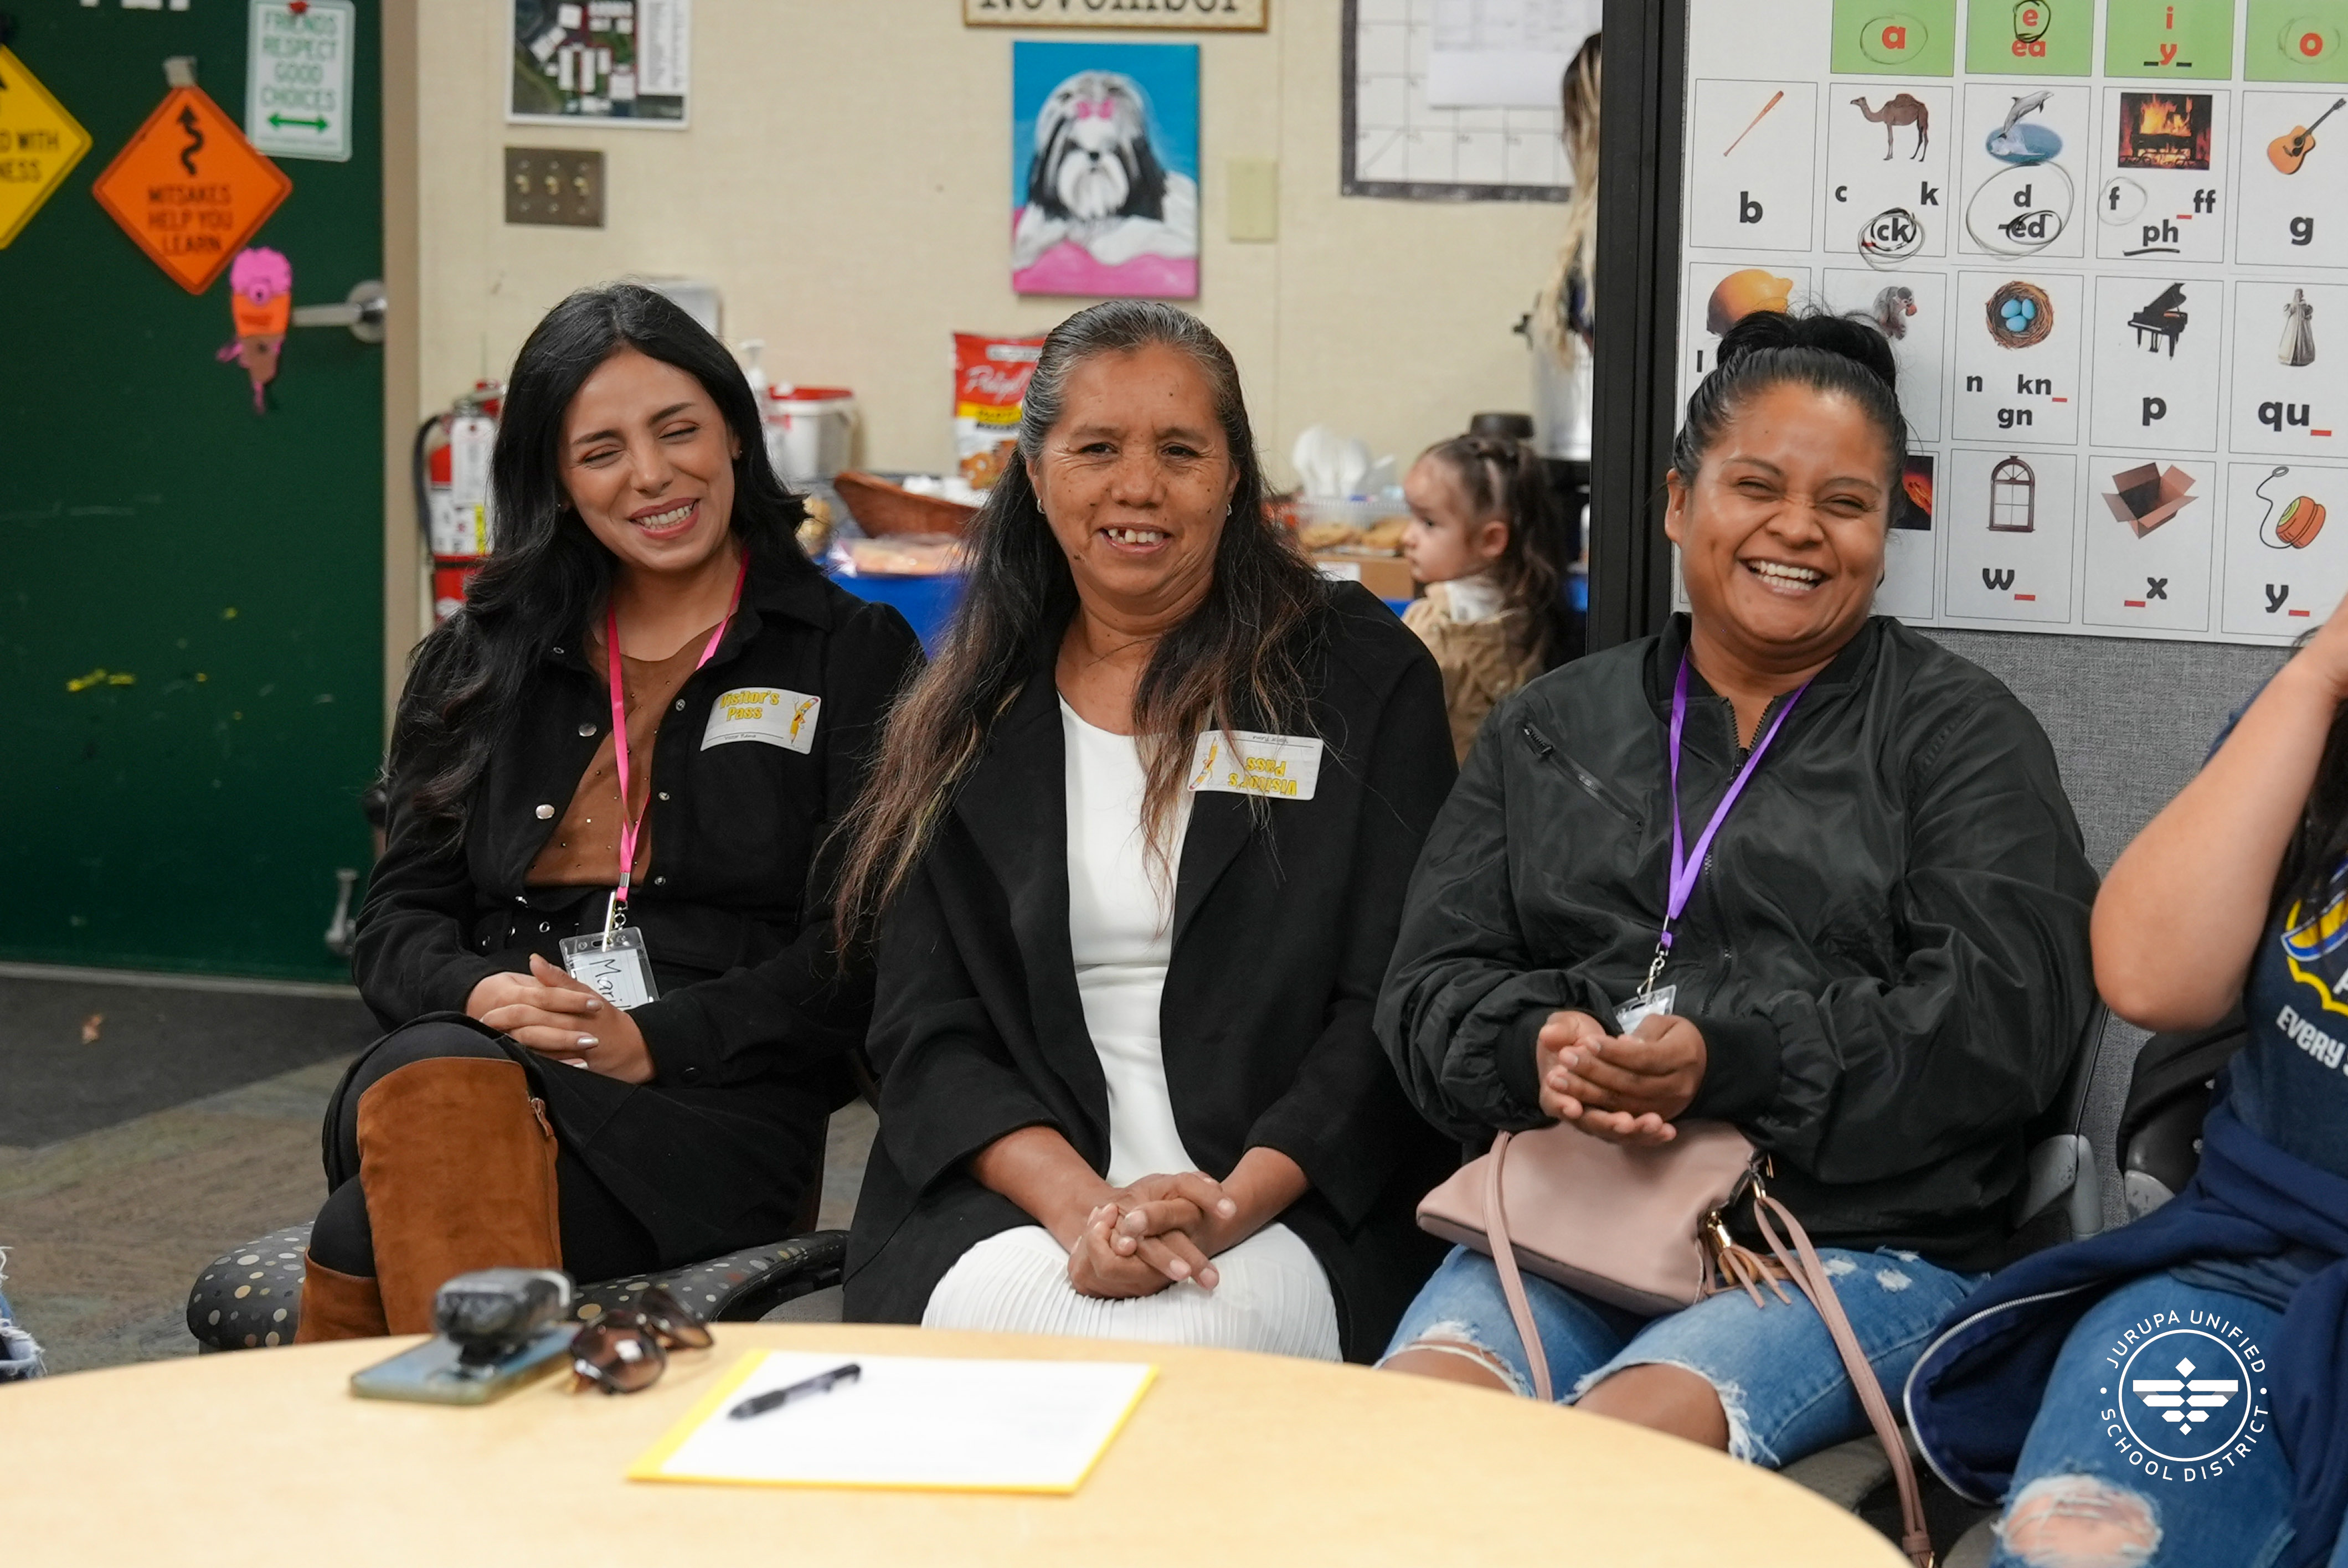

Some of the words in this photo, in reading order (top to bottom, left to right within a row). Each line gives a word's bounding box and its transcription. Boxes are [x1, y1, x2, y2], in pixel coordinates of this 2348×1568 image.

[2022, 9, 2038, 27] e
[2166, 7, 2173, 29] i
[1882, 27, 1906, 49] a
[2012, 39, 2046, 57] ea
[2300, 33, 2323, 56] o
[1835, 185, 1847, 203] c
[1920, 181, 1939, 205] k
[2014, 184, 2032, 208] d
[2109, 186, 2120, 210] f
[1739, 191, 1763, 224] b
[2143, 219, 2179, 247] ph
[2290, 216, 2314, 246] g
[1966, 375, 1983, 392] n
[1997, 408, 2032, 429] gn
[2142, 397, 2167, 426] p
[720, 690, 780, 709] Visitor's
[727, 706, 763, 721] Pass
[1245, 756, 1286, 777] Pass
[1228, 772, 1297, 796] Visitor's
